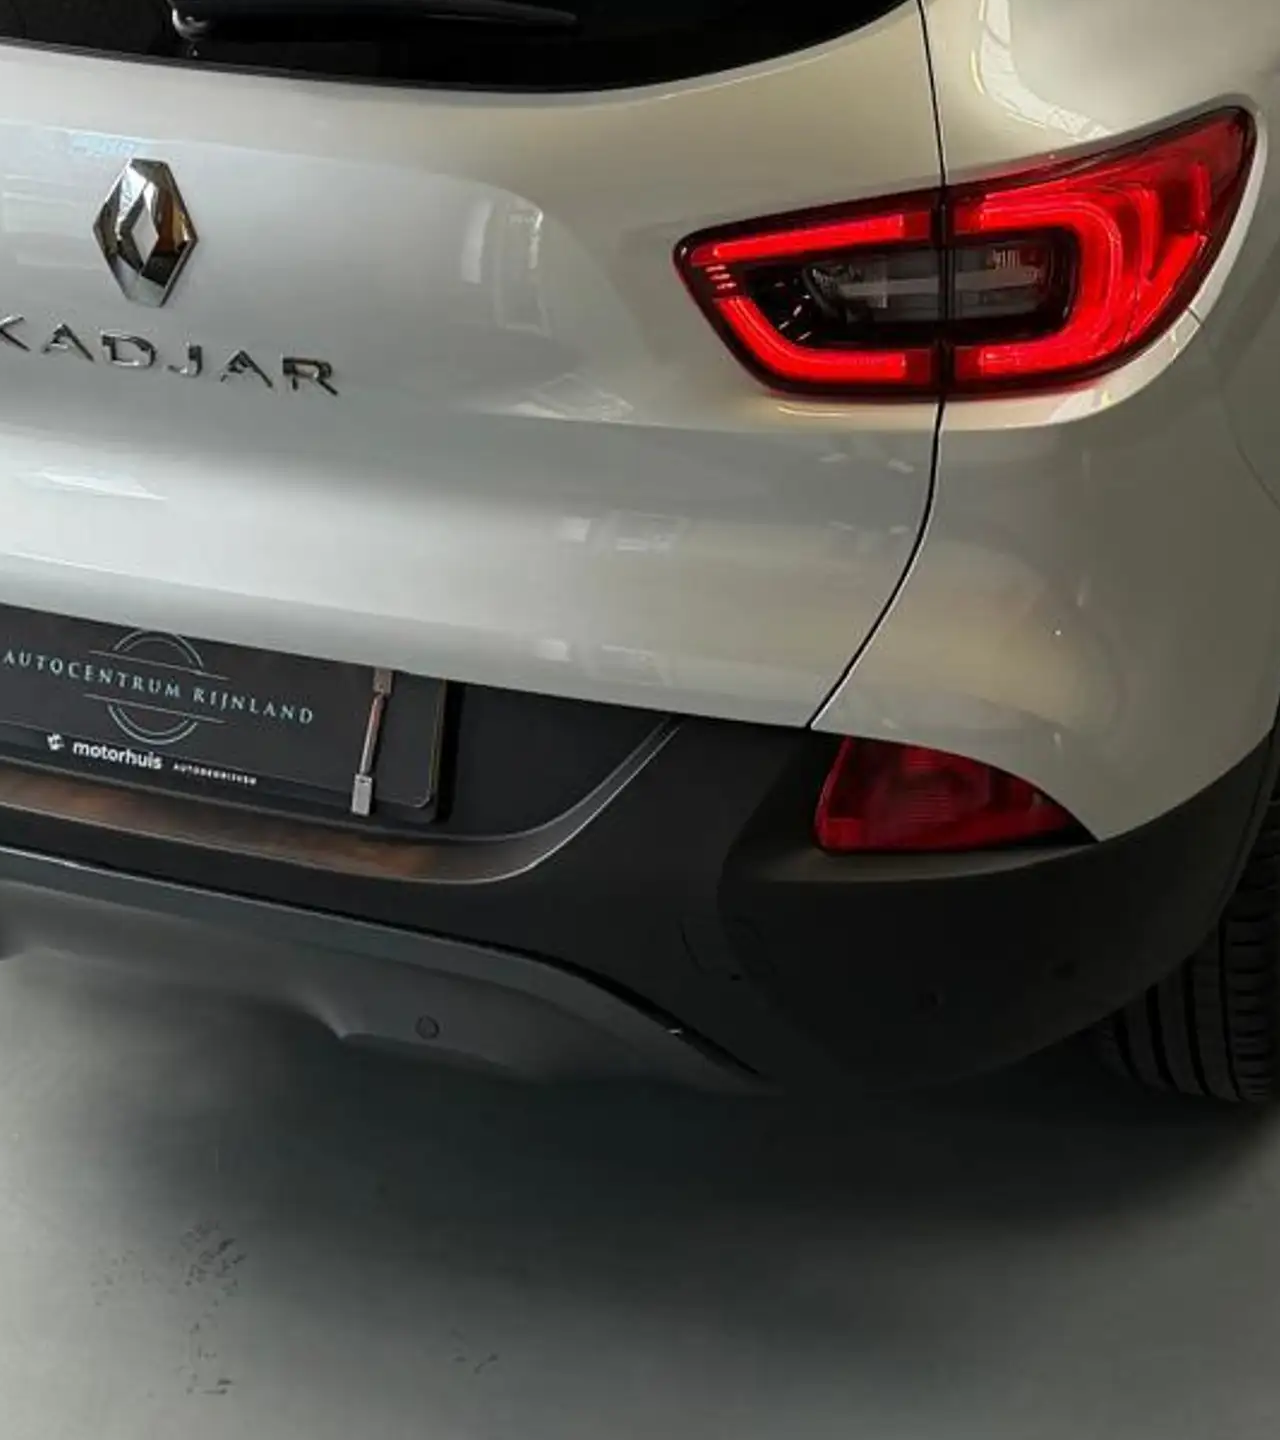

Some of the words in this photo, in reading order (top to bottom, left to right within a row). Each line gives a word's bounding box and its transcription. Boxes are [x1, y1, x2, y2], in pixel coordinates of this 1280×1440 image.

[3, 649, 181, 699] AUTOCENTRUM
[193, 687, 314, 725] RIJNLAND
[72, 741, 162, 770] motorhuis
